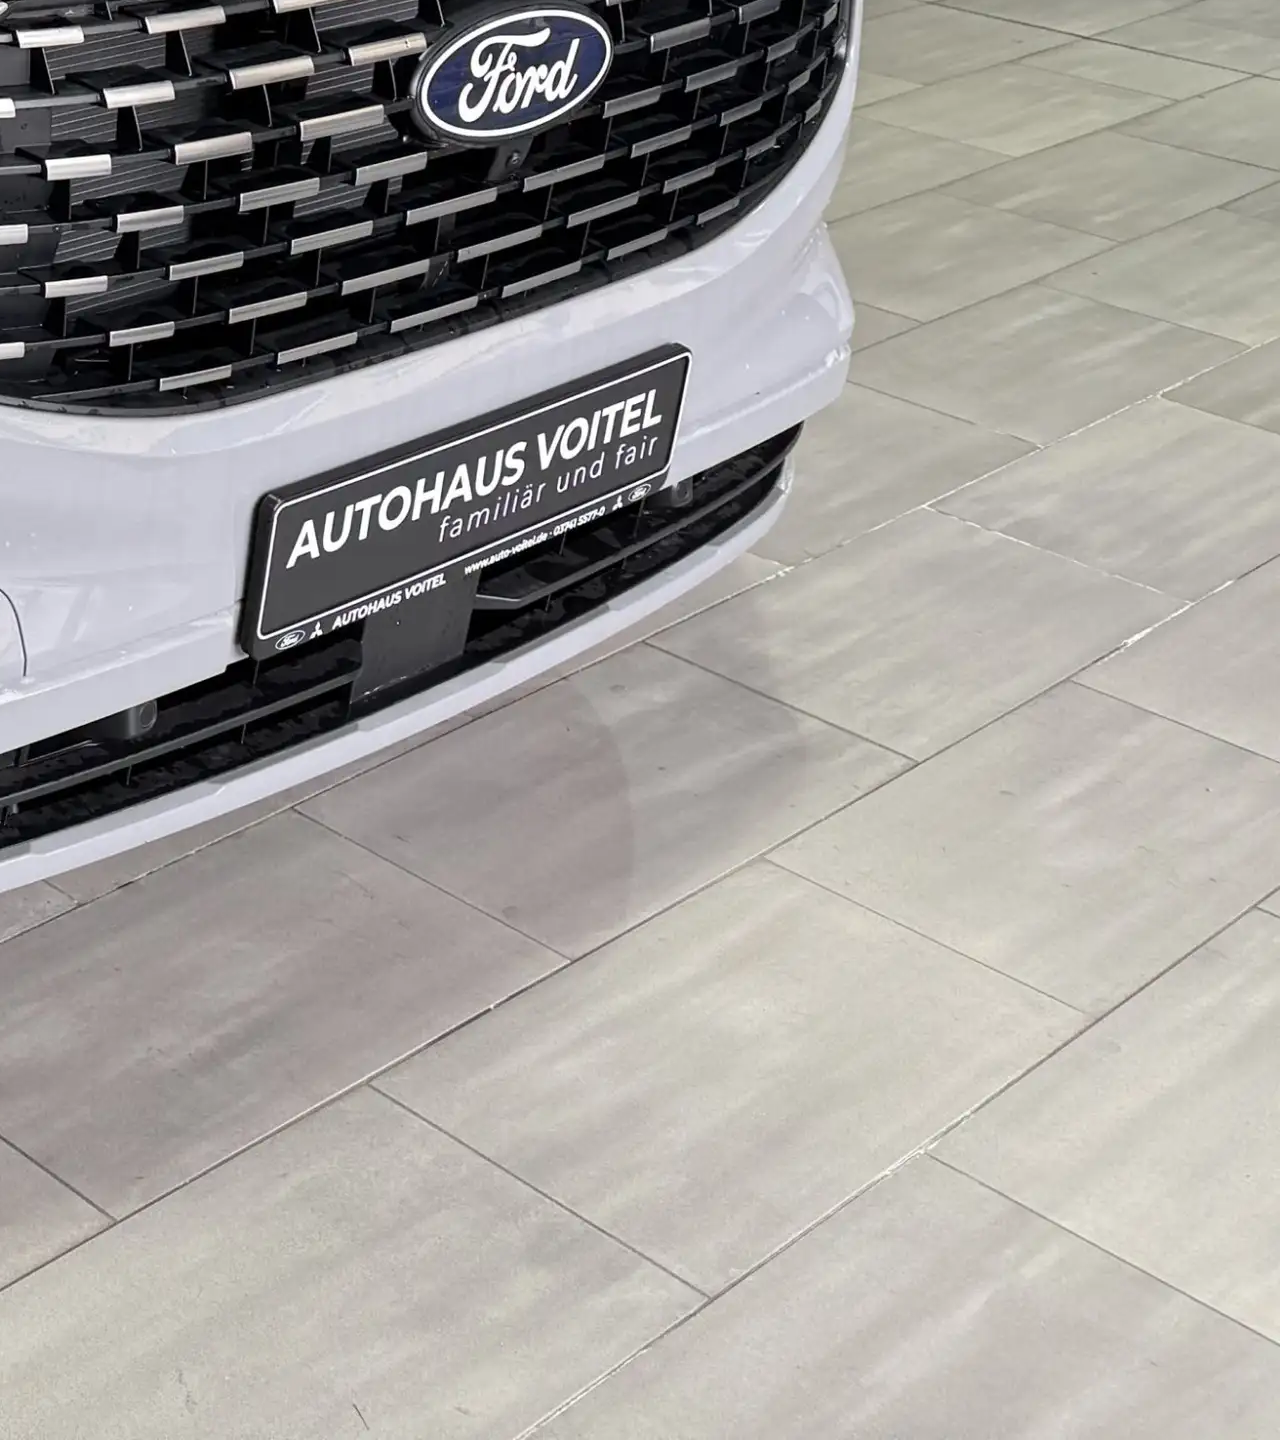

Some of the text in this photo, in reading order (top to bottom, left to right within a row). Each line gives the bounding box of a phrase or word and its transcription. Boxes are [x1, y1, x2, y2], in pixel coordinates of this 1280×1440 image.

[458, 27, 580, 123] Ford
[285, 388, 663, 569] AUTOHAUS VOITEL
[438, 435, 659, 543] familiär und fair
[464, 531, 548, 575] www.auto-voitel.de
[331, 573, 447, 630] AUTOHAUS VOITEL
